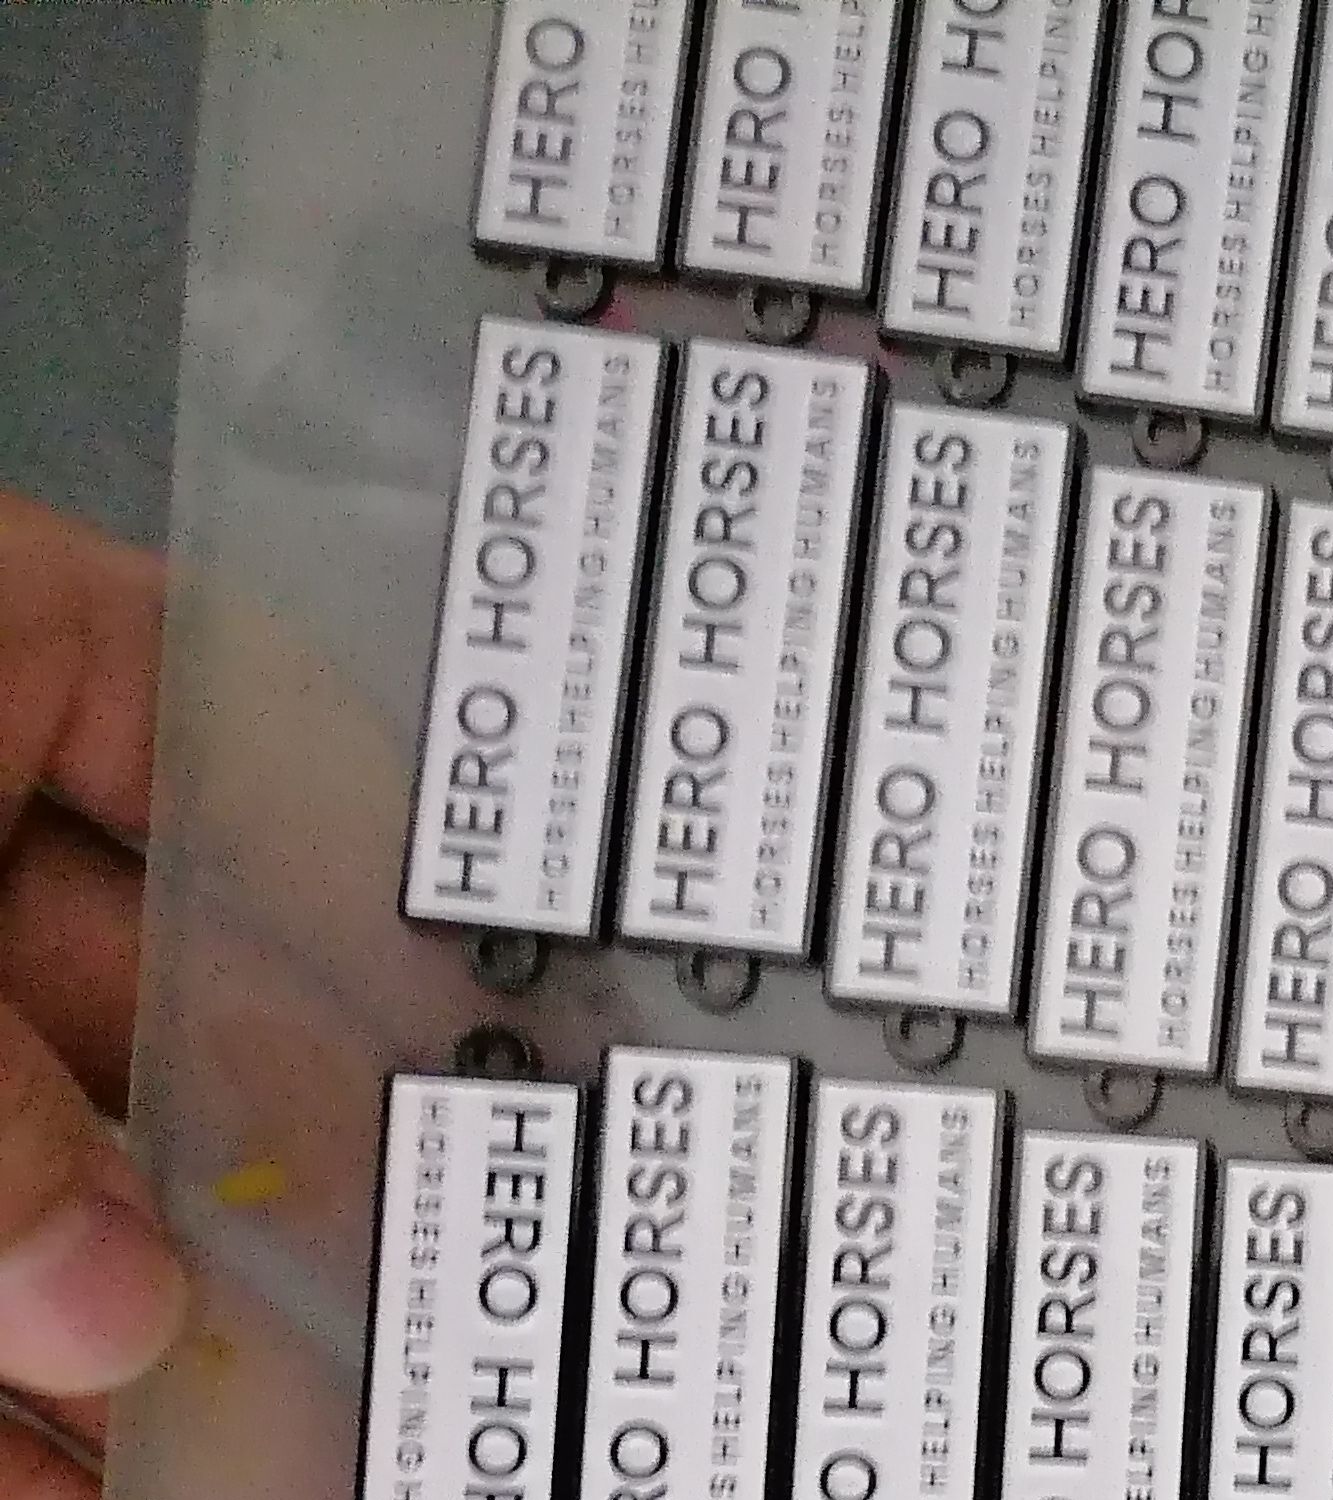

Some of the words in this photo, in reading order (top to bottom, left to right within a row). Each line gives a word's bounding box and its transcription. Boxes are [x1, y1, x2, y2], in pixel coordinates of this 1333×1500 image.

[501, 17, 588, 231] HERO
[710, 43, 796, 258] HERO
[1222, 46, 1272, 224] HELPING
[1107, 172, 1190, 384] HERO
[1202, 229, 1251, 393] HORSES
[464, 341, 565, 653] HORSES
[884, 427, 976, 735] HORSES
[432, 681, 522, 903] HERO
[858, 763, 940, 980] HERO
[474, 1102, 551, 1323] HERO
[613, 1070, 695, 1386] HORSES
[721, 1073, 765, 1264] HUMANS
[709, 1272, 752, 1462] HELPING
[1028, 1155, 1106, 1464] HORSES
